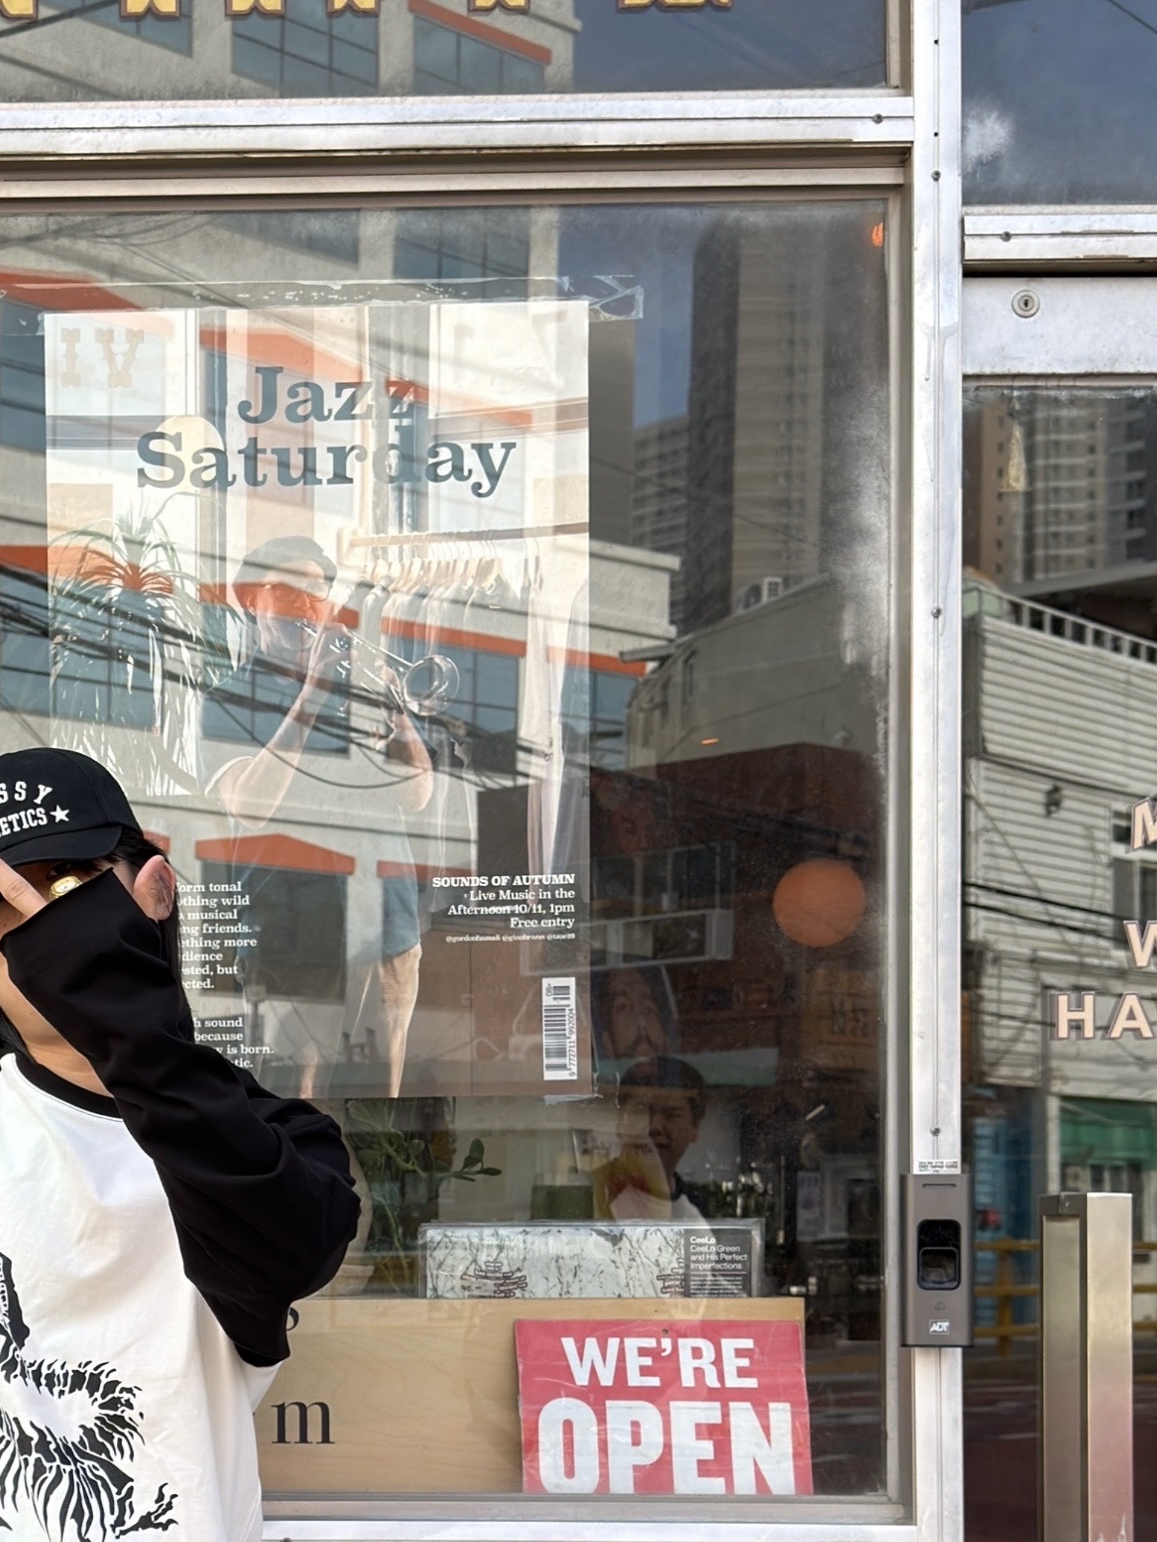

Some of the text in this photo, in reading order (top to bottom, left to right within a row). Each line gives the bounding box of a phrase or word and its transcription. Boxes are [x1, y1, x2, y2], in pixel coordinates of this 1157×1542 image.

[237, 366, 415, 425] Jazz
[136, 424, 517, 498] Saturday
[432, 873, 575, 888] SOUNDS OF AUTUMN
[209, 881, 242, 892] tonal
[469, 888, 575, 901] Live Music in the
[221, 895, 250, 906] wild
[187, 909, 238, 920] musical
[448, 905, 511, 915] Afternoon
[549, 903, 575, 916] 1pm
[202, 923, 252, 934] friends.
[510, 917, 575, 929] Free entry
[224, 938, 258, 947] more
[217, 964, 239, 975] but
[204, 1017, 243, 1028] sound
[194, 1032, 243, 1041] because
[227, 1044, 238, 1055] is
[240, 1044, 275, 1054] born.
[690, 1236, 716, 1244] CeeLo
[690, 1244, 741, 1253] CeeLo Green
[690, 1253, 704, 1261] and
[720, 1253, 748, 1261] Perfect
[690, 1262, 743, 1270] Imperfections
[929, 1321, 950, 1332] ADT
[538, 1397, 796, 1495] OPEN
